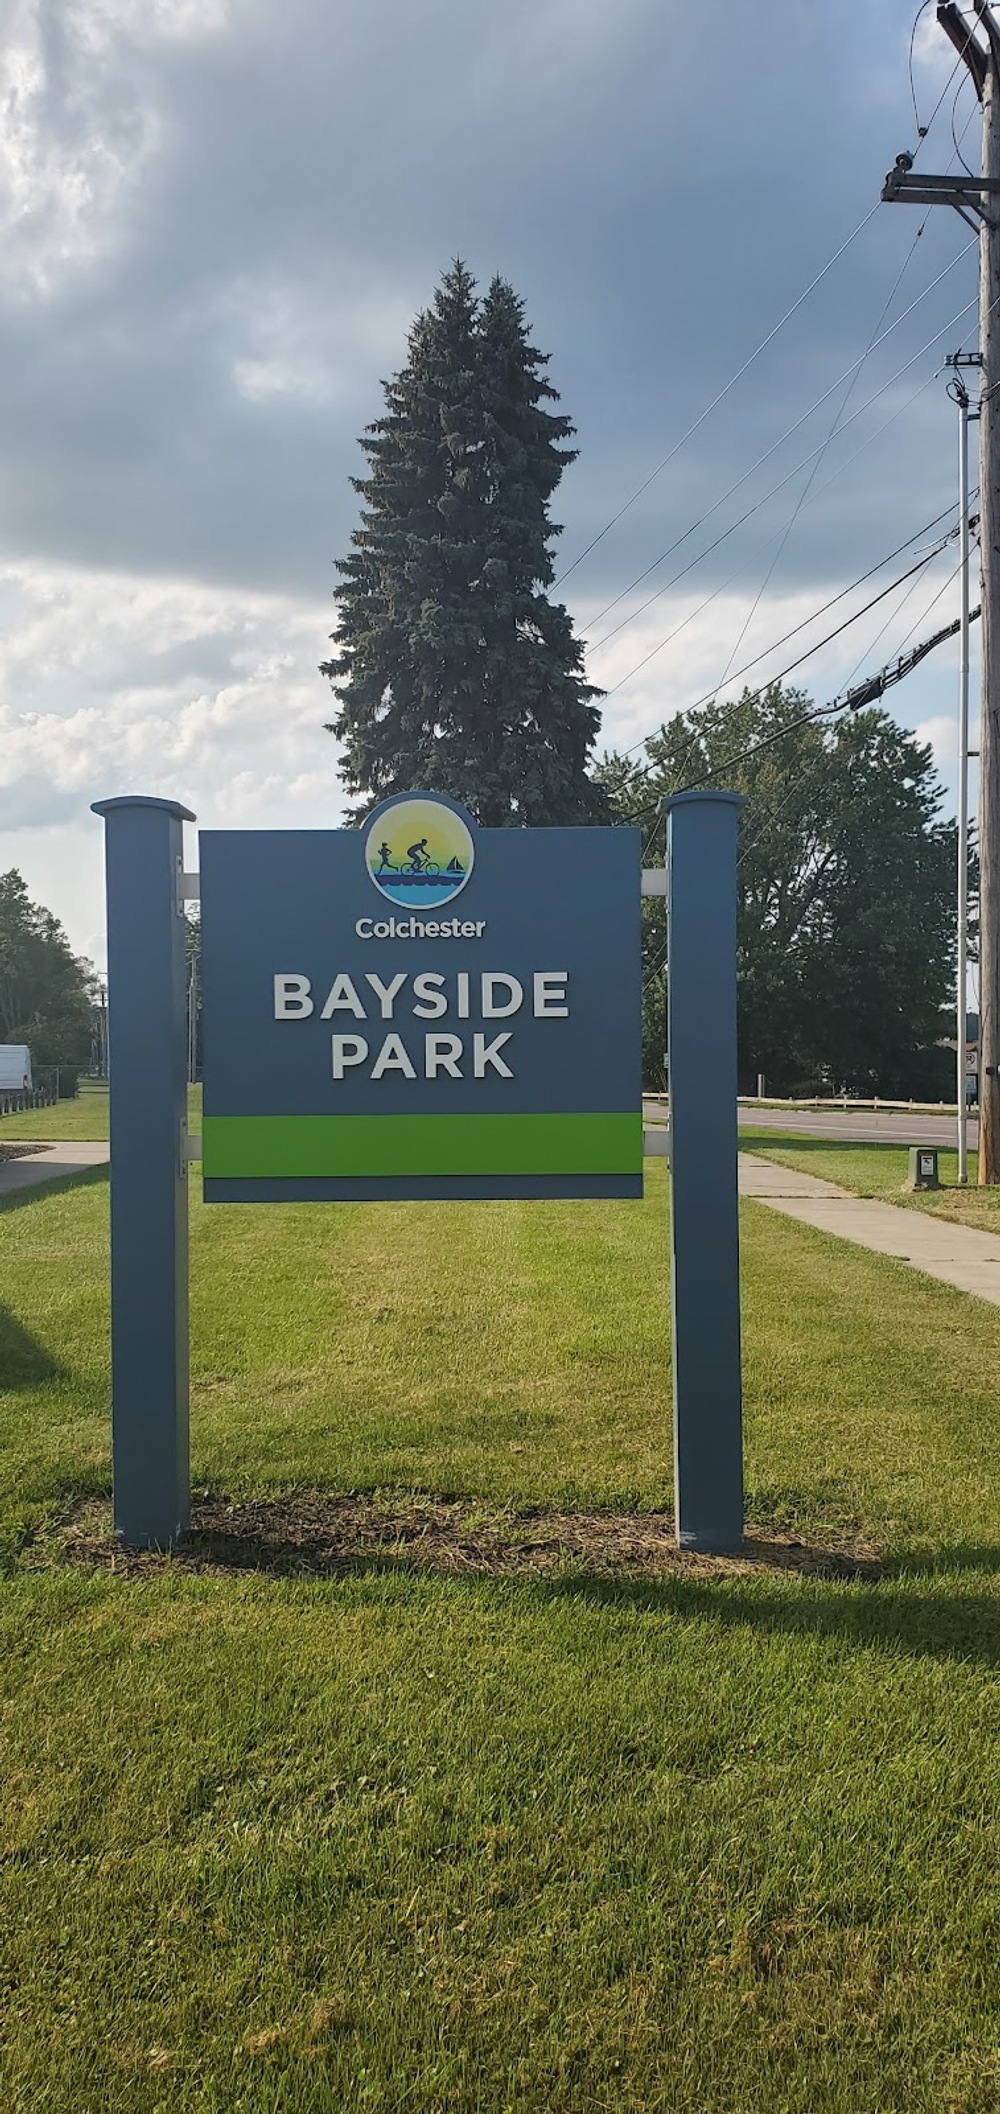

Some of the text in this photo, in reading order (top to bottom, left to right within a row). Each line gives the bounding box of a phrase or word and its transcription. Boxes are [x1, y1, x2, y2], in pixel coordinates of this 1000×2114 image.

[355, 918, 486, 938] Colchester
[274, 972, 569, 1019] BAYSIDE
[332, 1033, 514, 1079] PARK
